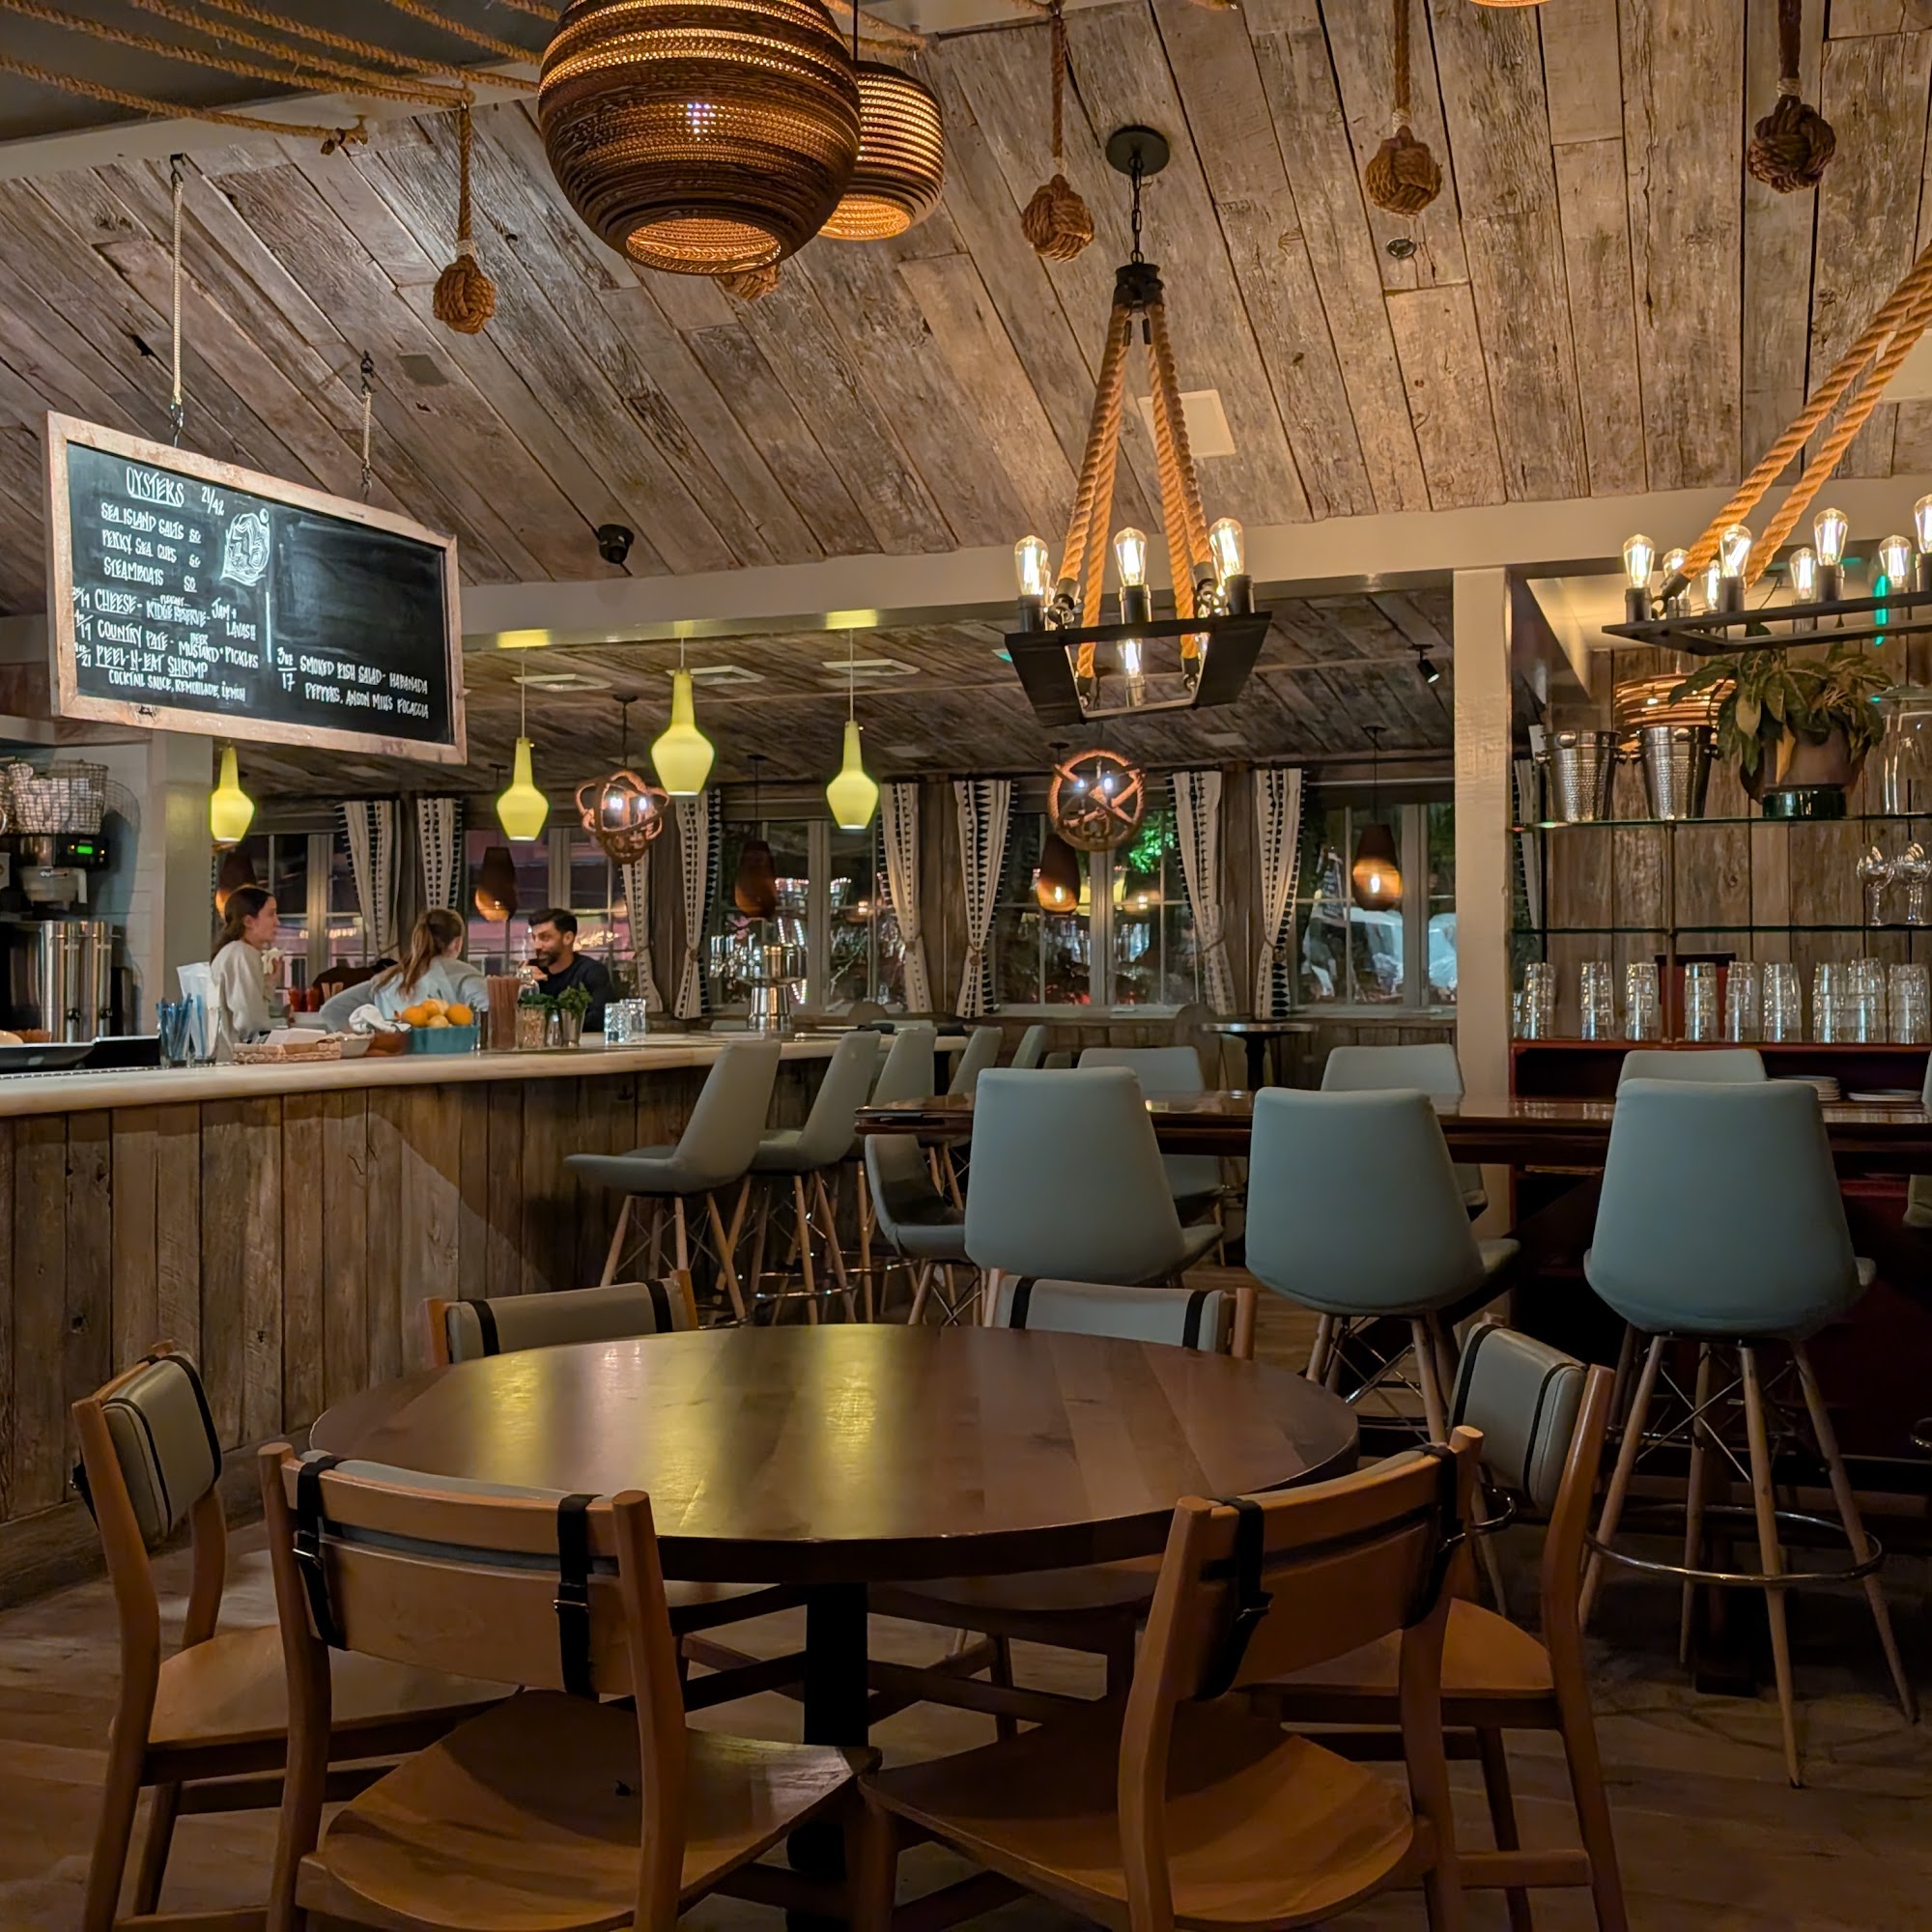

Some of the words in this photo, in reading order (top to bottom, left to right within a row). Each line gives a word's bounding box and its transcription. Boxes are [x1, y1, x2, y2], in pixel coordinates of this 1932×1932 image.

[127, 467, 185, 507] OYSTERS
[201, 486, 225, 516] 21/42
[101, 502, 120, 524] SEA
[124, 508, 156, 532] ISLAND
[158, 519, 185, 540] SALTS
[102, 528, 132, 555] PERKY
[135, 537, 154, 557] SEA
[157, 543, 178, 563] CUPS
[103, 556, 164, 586] STEAMBOATS
[212, 596, 230, 620] JAM
[98, 619, 142, 648] COUNTRY
[226, 620, 256, 641] LAVASH
[167, 655, 209, 679] SHRIMP
[178, 639, 220, 664] MUSTARD
[224, 645, 259, 668] PICKLES
[108, 668, 145, 688] COCKTAIL
[281, 672, 296, 693] 17
[299, 655, 335, 676] SMOKED
[337, 662, 355, 681] FISH
[389, 672, 428, 695] HABANADA
[345, 690, 370, 707] ANSON
[372, 694, 393, 711] MILLS
[397, 697, 429, 720] FOCACCIA
